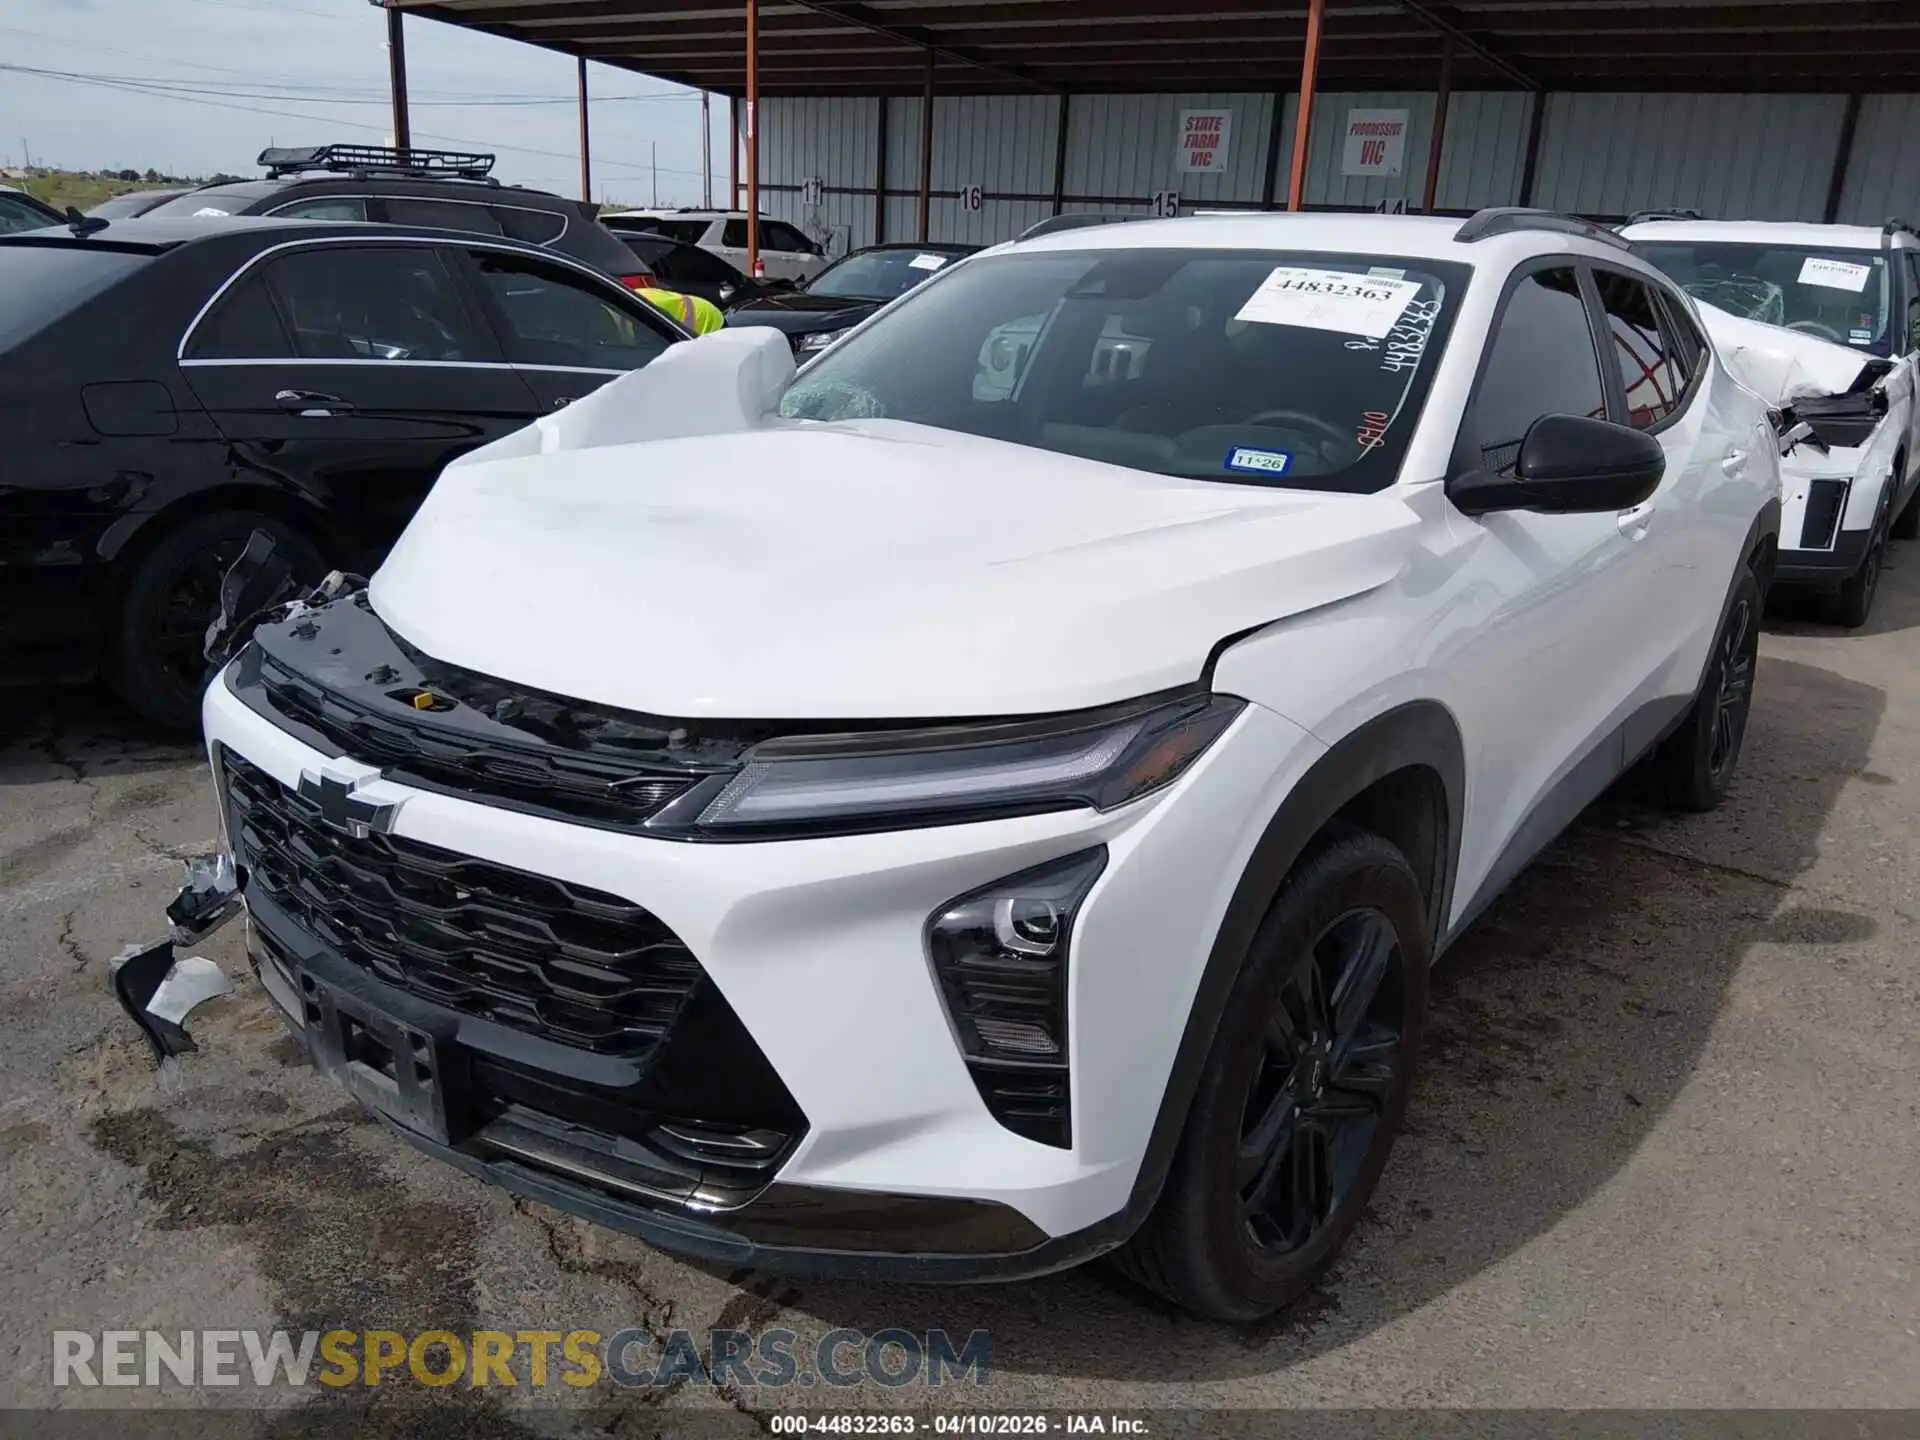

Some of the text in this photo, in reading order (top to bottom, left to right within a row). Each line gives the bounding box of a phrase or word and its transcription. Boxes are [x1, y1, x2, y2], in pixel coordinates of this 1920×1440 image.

[1185, 116, 1224, 132] STATE
[1350, 121, 1404, 136] PROGRESSIVE
[1184, 133, 1220, 148] FARM
[1190, 151, 1213, 167] VIC
[1361, 140, 1386, 166] VIC
[961, 187, 980, 210] 16
[1155, 192, 1177, 217] 15
[1277, 279, 1393, 301] 44832363
